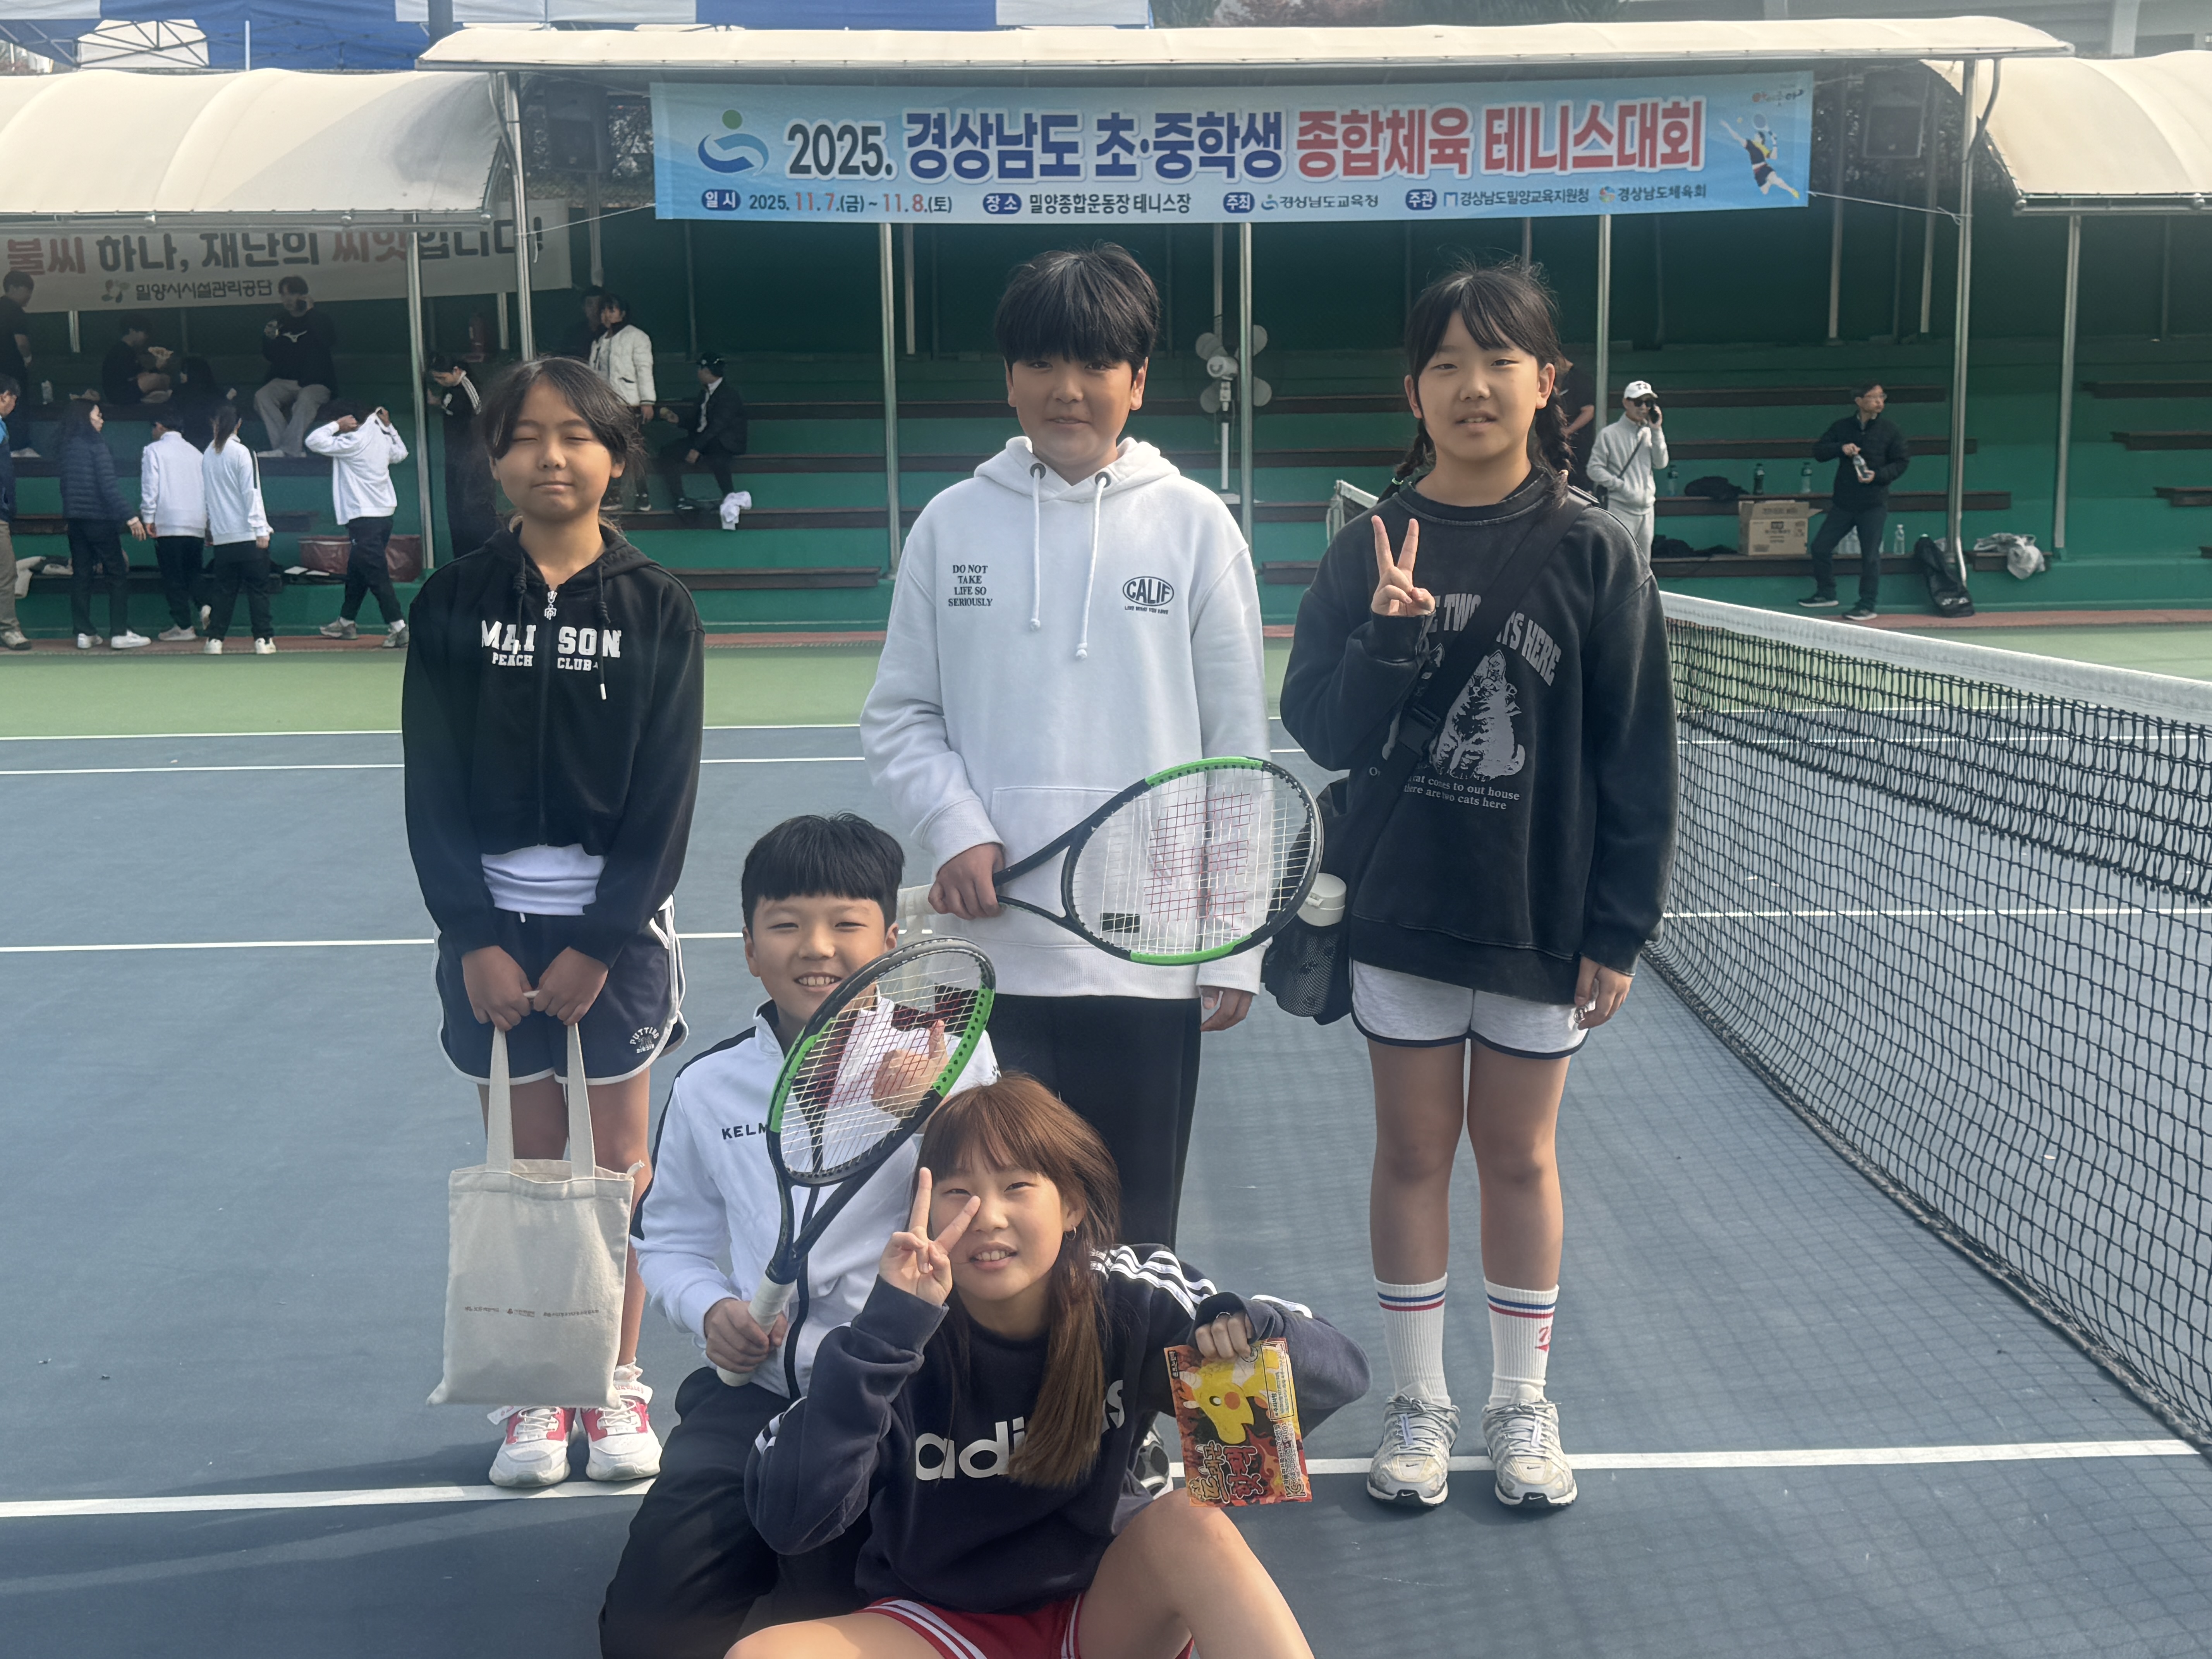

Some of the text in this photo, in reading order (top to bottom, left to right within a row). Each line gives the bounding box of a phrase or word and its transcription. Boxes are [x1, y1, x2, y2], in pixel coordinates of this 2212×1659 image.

[788, 101, 1702, 179] 2025. 경상남도 초·중학생 종합체육 테니스대회
[749, 194, 790, 211] 2025.
[1226, 194, 1379, 211] 주최 경상남도교육청
[1408, 188, 1589, 208] 주관 경상남도밀양교육지원청
[1618, 184, 1707, 202] 경상남도체육회
[1029, 194, 1130, 214] 밀양종합운동장
[1133, 193, 1192, 214] 테니스장
[7, 236, 86, 275] 불씨
[96, 233, 189, 272] 하나,
[199, 233, 319, 268] 재난의
[136, 280, 273, 301] 밀양시시설관리공단
[953, 565, 988, 574] DO NOT
[957, 575, 982, 584] TAKE
[954, 586, 987, 595] LIFE SO
[1127, 579, 1171, 604] CALIF
[948, 598, 993, 606] SERIOUSLY
[492, 652, 592, 671] PEACH CLUB
[1522, 619, 1561, 686] HERE
[1404, 783, 1424, 794] there
[1425, 789, 1441, 799] are
[1458, 795, 1480, 805] cats
[1482, 797, 1507, 810] here
[1453, 783, 1465, 792] to
[1467, 786, 1486, 795] out
[1488, 787, 1520, 801] house
